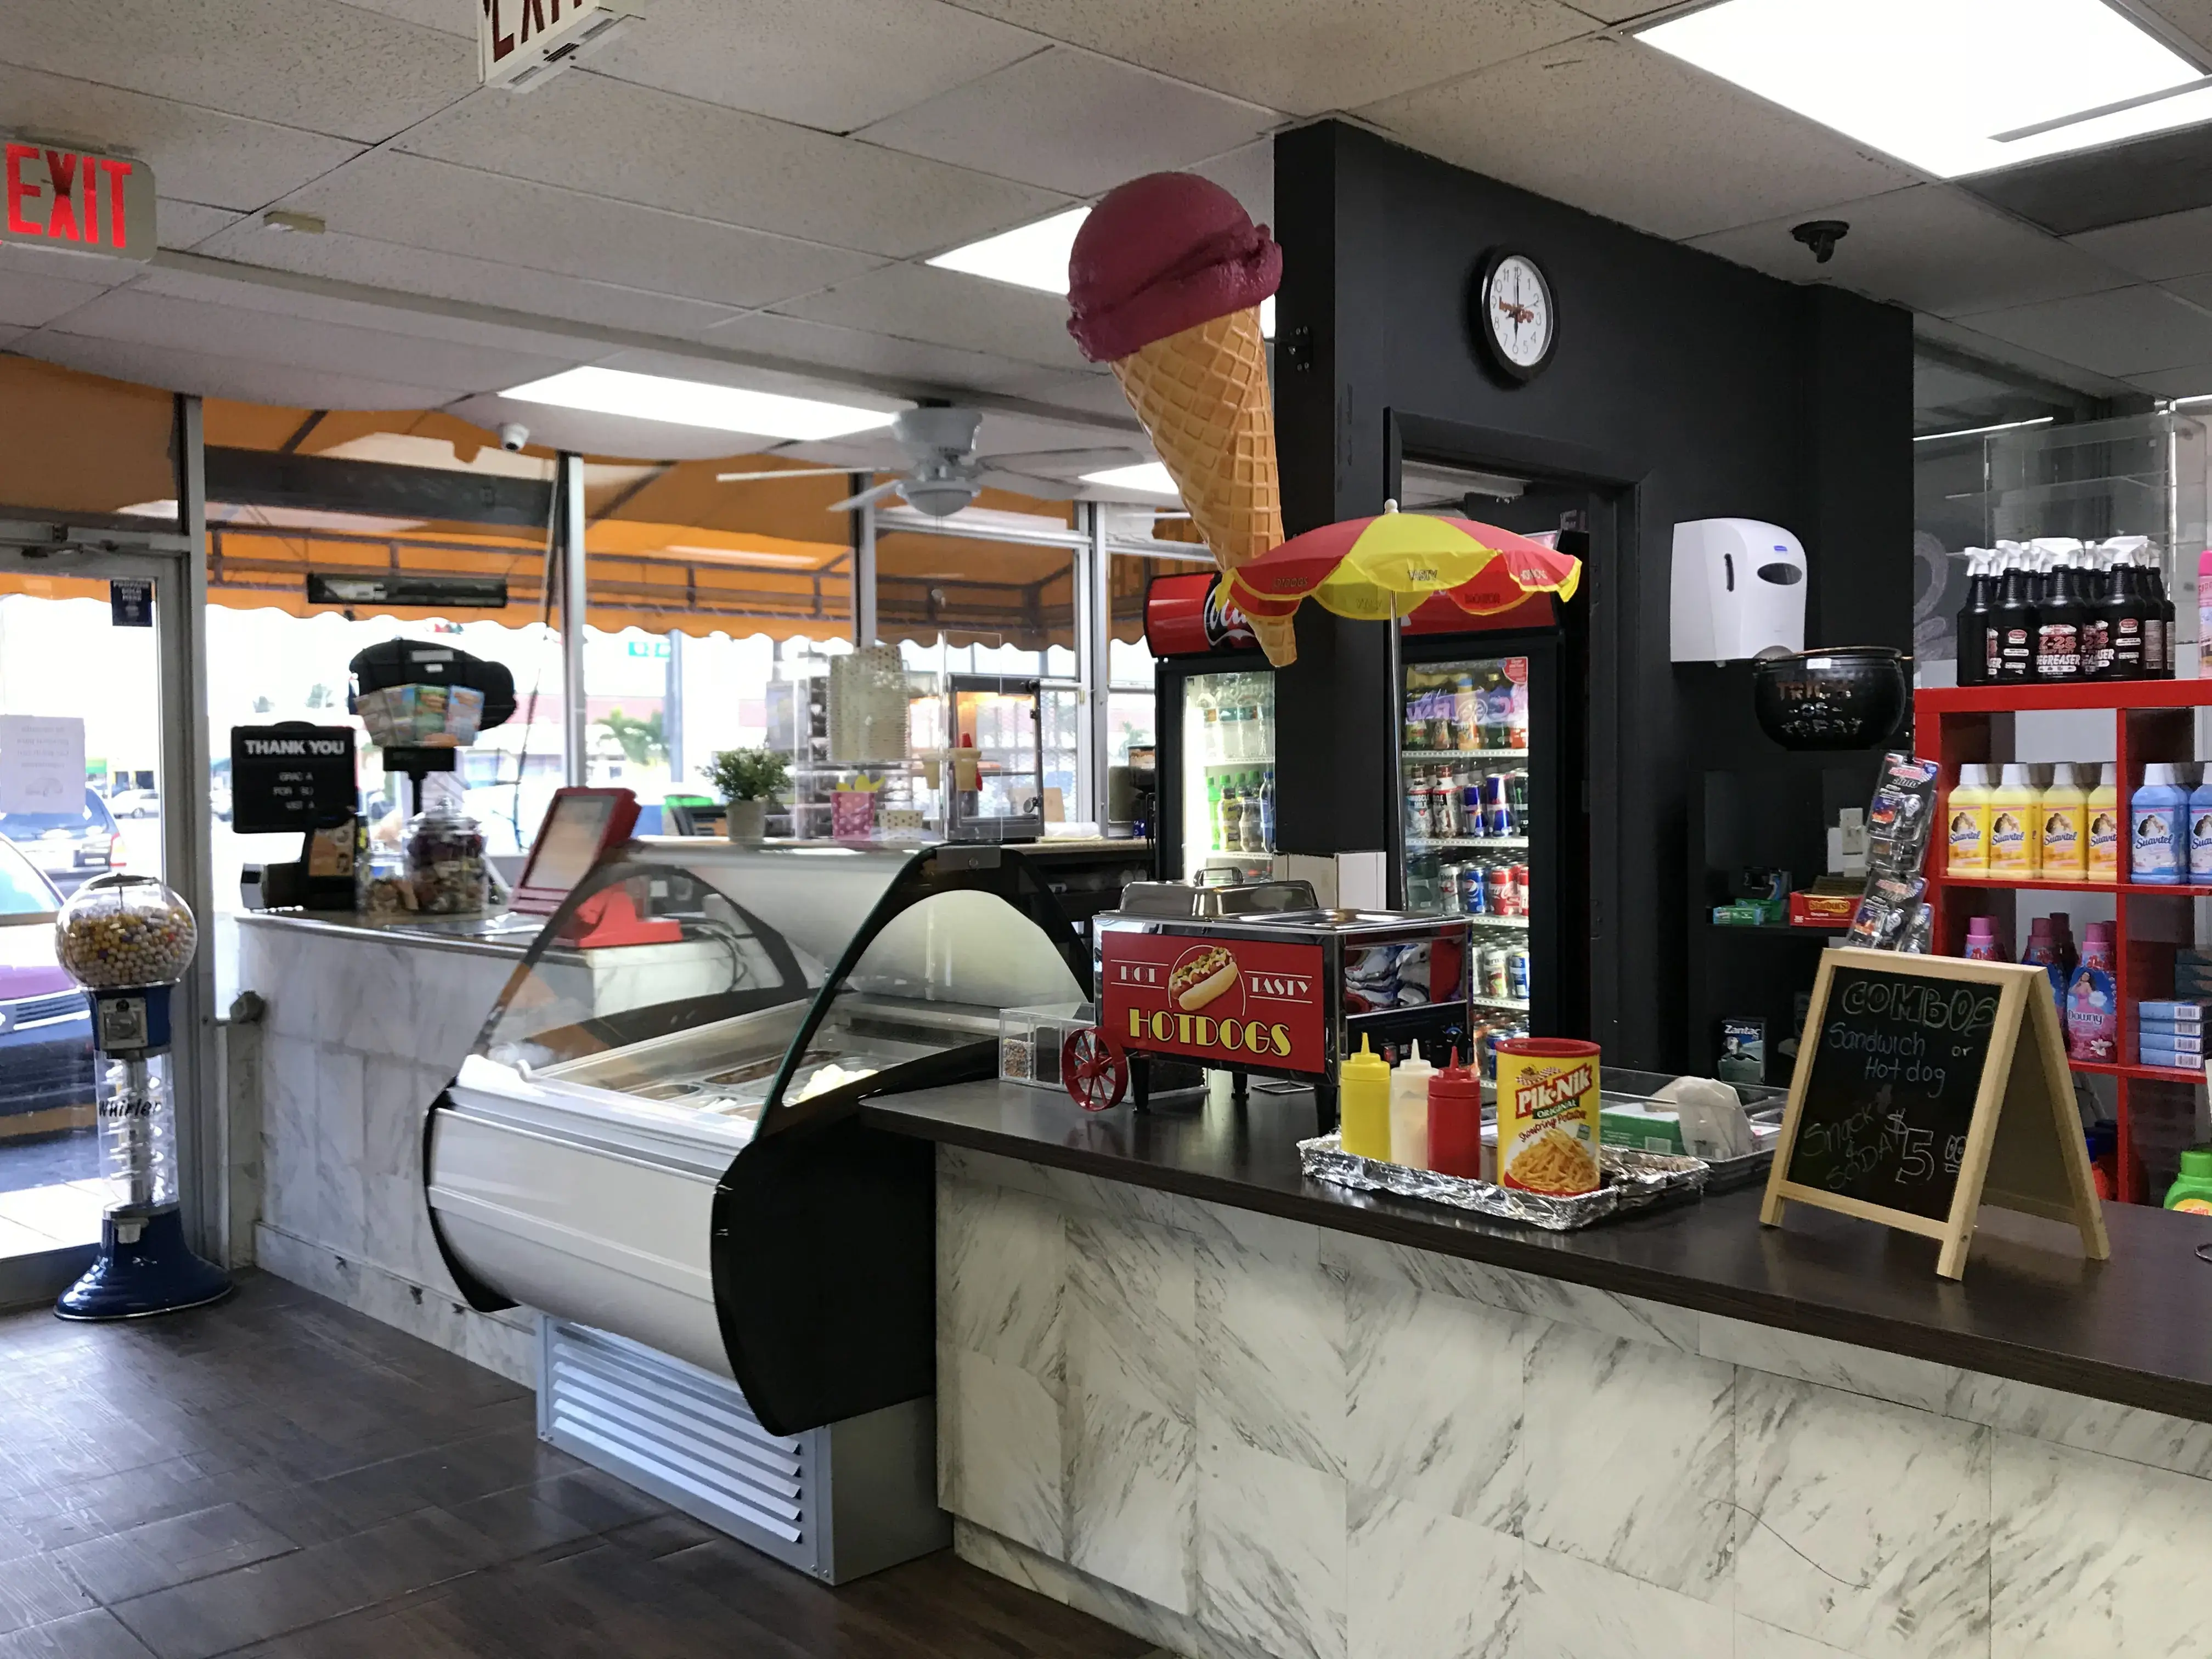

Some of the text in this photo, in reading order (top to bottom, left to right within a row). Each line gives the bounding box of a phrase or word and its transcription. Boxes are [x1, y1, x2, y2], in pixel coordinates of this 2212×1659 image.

[6, 143, 132, 249] EXIT
[1502, 268, 1509, 283] 11
[1493, 278, 1503, 293] 10
[1527, 278, 1531, 291] 1
[1491, 295, 1497, 309] 9
[1533, 293, 1539, 307] 2
[1493, 317, 1500, 330] 8
[1536, 312, 1542, 326] 3
[1503, 333, 1508, 347] 7
[1530, 331, 1537, 344] 4
[1512, 342, 1519, 354] 6
[1522, 340, 1528, 354] 5
[1407, 569, 1437, 582] TASTY
[244, 740, 345, 755] THANK YOU
[1949, 830, 1981, 845] Suavitel
[1993, 831, 2025, 845] Suavitel
[2044, 831, 2078, 846] Suavitel
[2136, 833, 2174, 849] Suavitel
[1120, 966, 1158, 983] HOT
[1249, 976, 1312, 997] TASTY
[1842, 981, 1999, 1037] COMBOS
[2068, 1009, 2102, 1025] Downy
[1128, 1008, 1293, 1057] HOTDOGS
[1724, 1024, 1762, 1035] Zantac
[1829, 1022, 1974, 1058] Sandwich or
[1866, 1056, 1946, 1098] Hot dog
[1801, 1103, 1875, 1156] Snack
